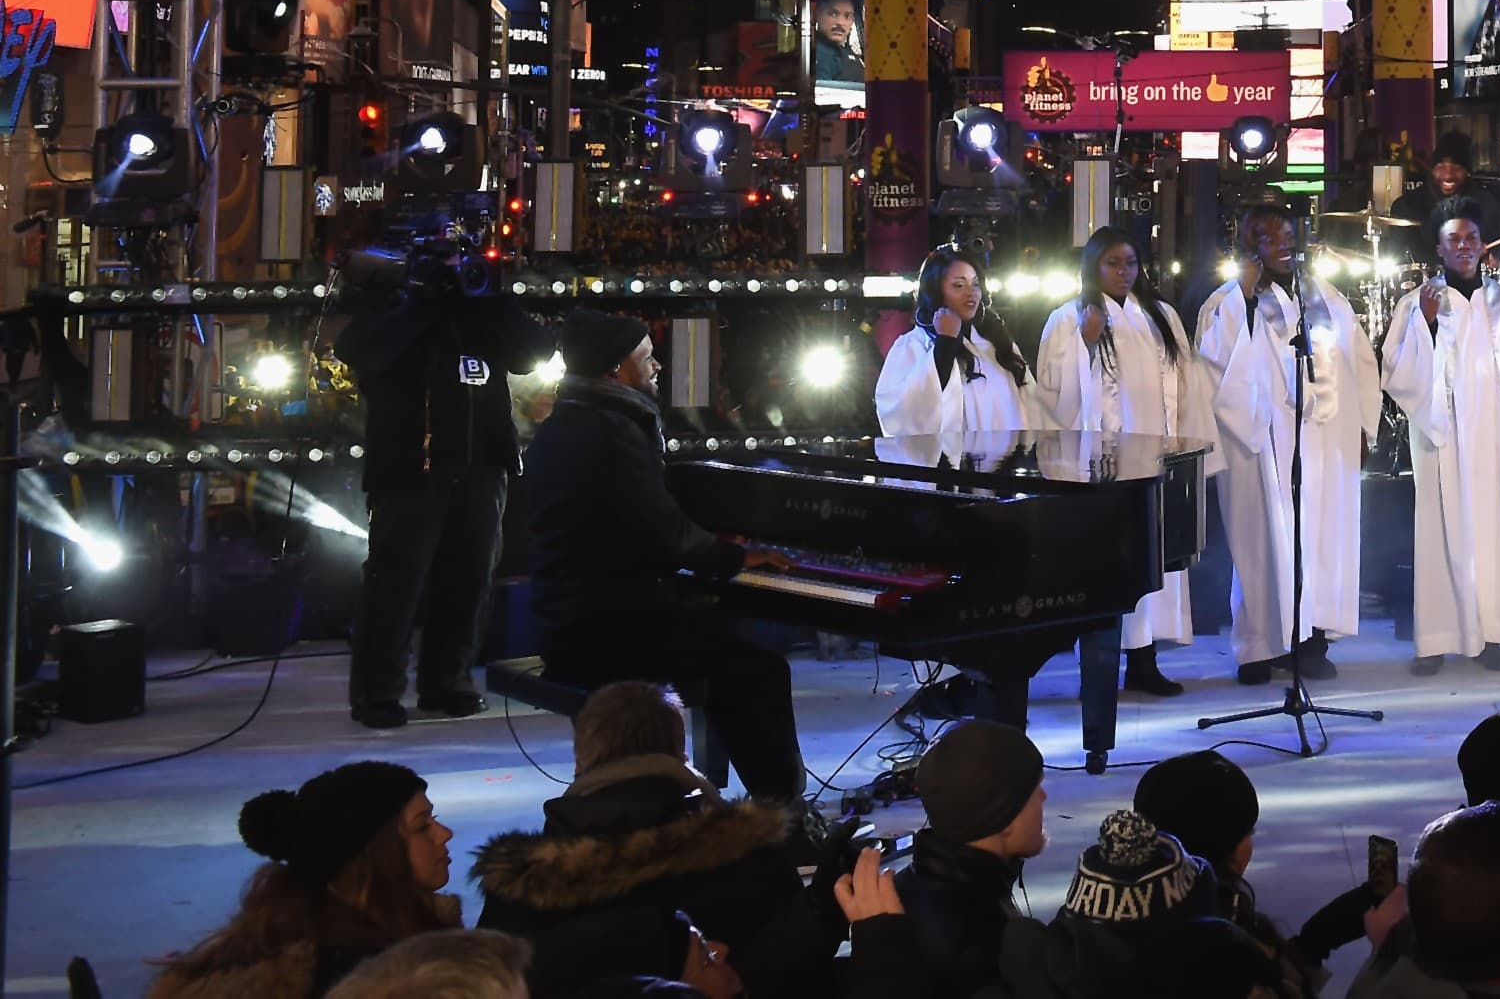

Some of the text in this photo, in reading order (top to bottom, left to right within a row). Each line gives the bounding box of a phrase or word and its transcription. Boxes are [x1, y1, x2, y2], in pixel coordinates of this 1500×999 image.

[702, 85, 776, 99] TOSHIBA
[1024, 90, 1063, 105] planet
[1089, 80, 1275, 105] bring on the year
[1029, 101, 1072, 112] fitness
[868, 182, 916, 198] planet
[1034, 593, 1087, 609] GRAND
